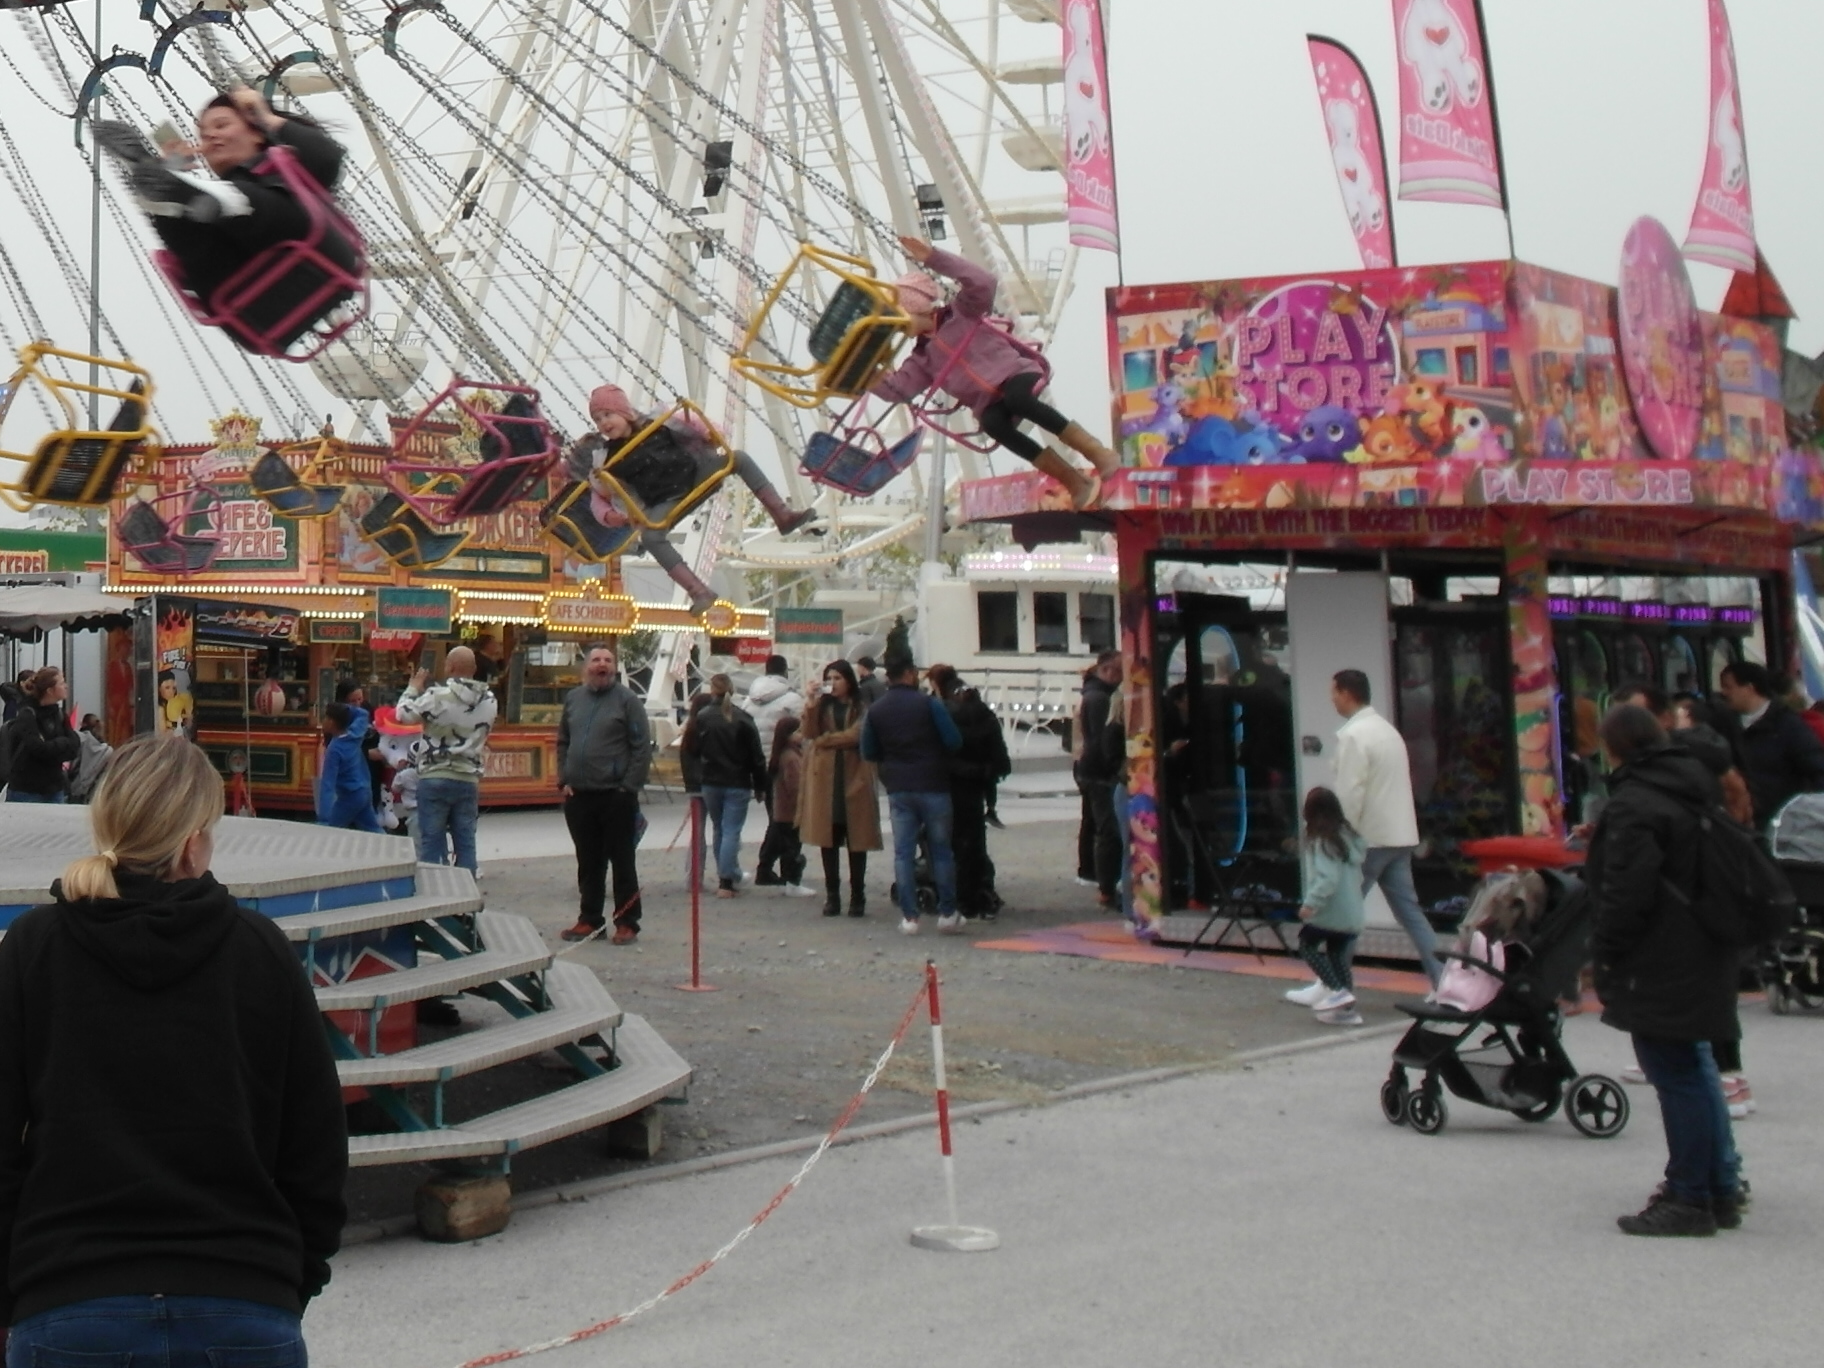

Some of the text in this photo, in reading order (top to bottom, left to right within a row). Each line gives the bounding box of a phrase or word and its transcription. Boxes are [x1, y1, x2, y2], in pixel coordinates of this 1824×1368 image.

[1236, 308, 1386, 366] PLAY
[1236, 365, 1394, 415] STORE
[1481, 468, 1693, 504] PLAY STORE
[548, 601, 626, 621] CAFE SCHREIBER
